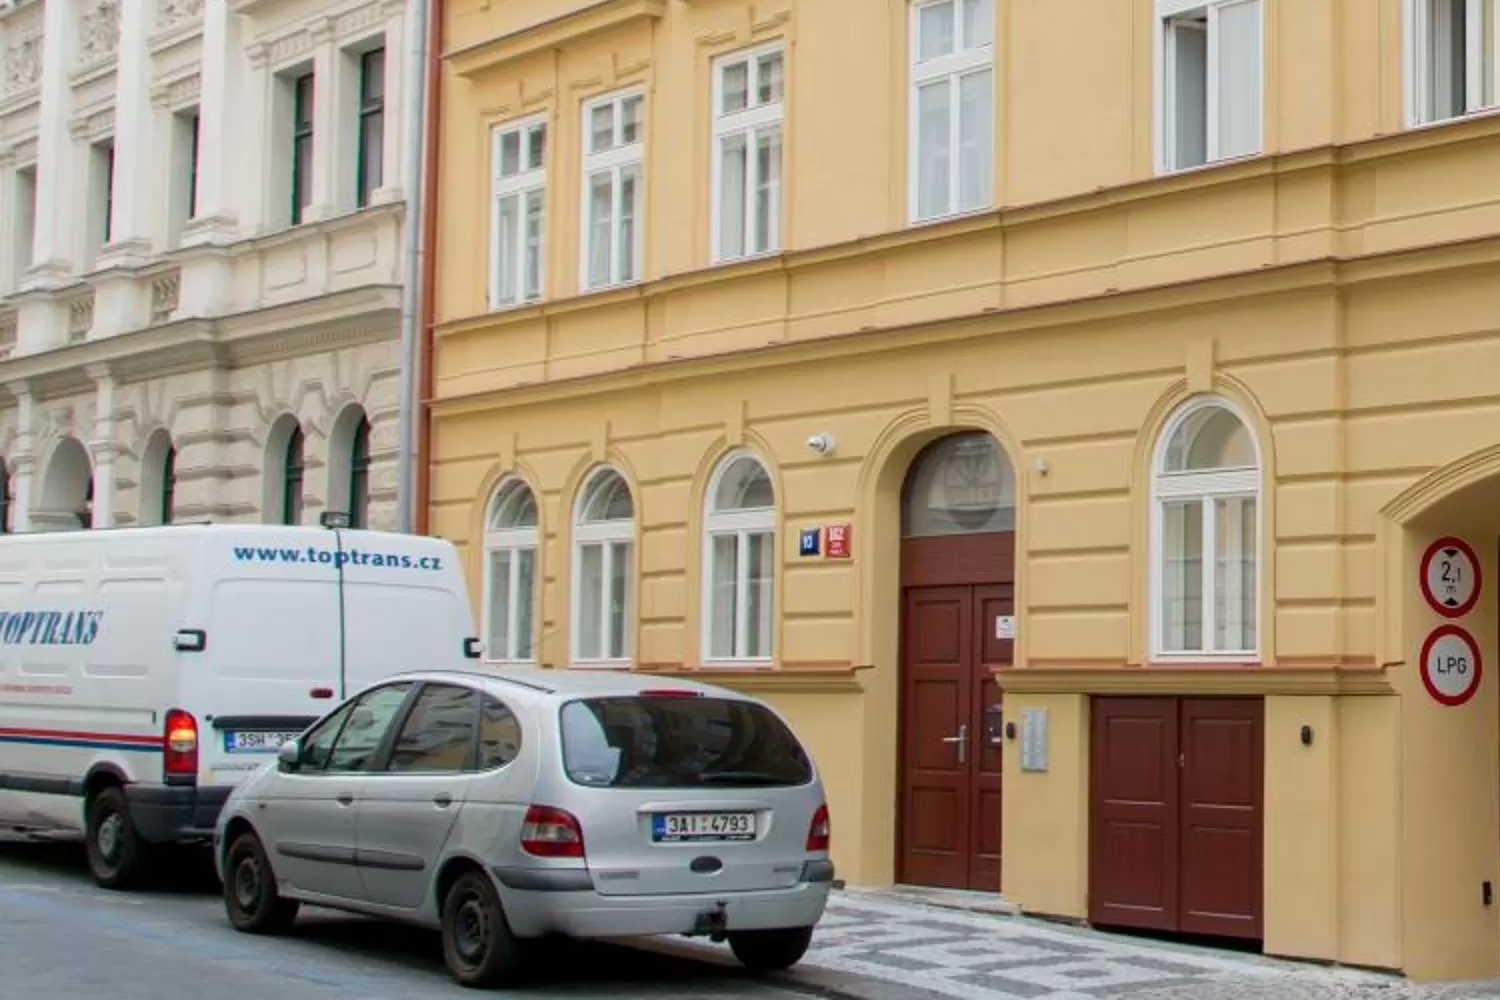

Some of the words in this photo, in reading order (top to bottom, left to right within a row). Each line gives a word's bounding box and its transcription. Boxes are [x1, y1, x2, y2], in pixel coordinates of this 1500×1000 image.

[233, 545, 443, 570] www.toptrans.cz
[1437, 656, 1467, 674] LPG
[711, 815, 748, 832] 4793
